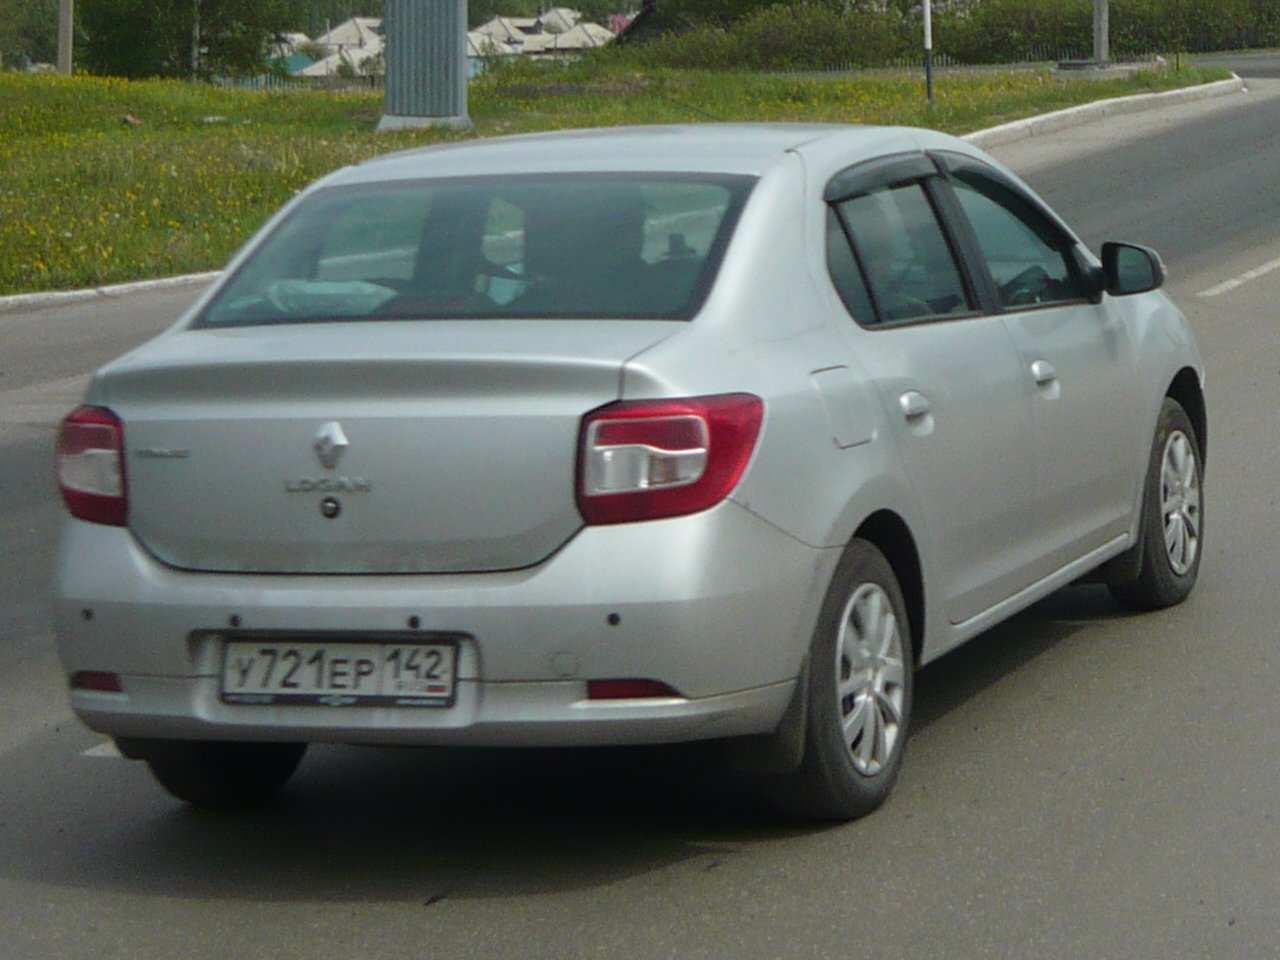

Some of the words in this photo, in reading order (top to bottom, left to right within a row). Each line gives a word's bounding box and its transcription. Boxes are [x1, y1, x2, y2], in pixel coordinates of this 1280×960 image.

[283, 477, 373, 493] LOGAN
[233, 648, 375, 689] У721ЕР
[386, 647, 443, 680] 142
